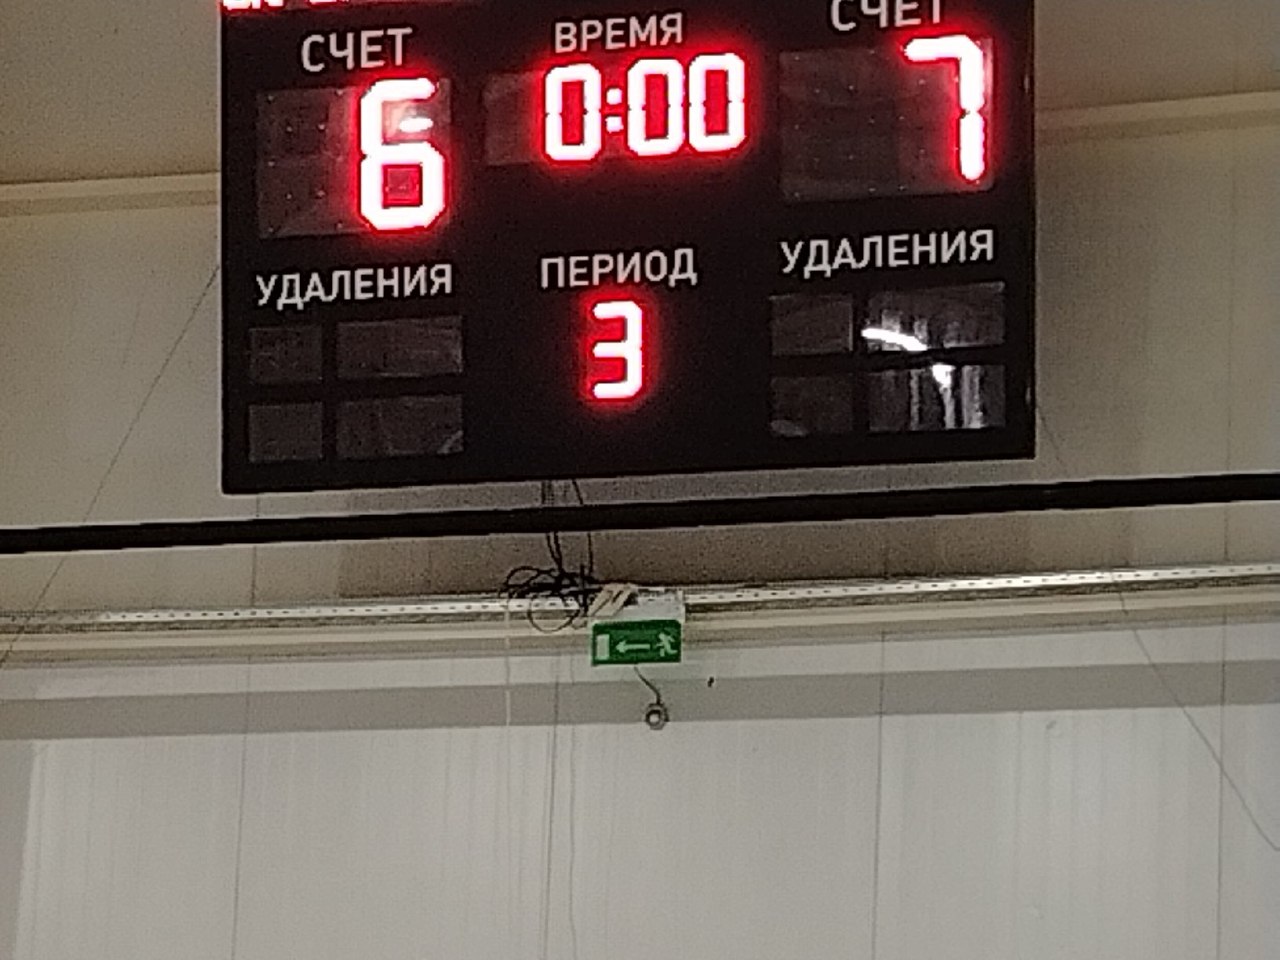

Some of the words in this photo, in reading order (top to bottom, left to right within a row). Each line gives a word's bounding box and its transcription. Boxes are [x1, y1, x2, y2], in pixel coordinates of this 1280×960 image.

[300, 26, 414, 73] СЧЕТ
[553, 13, 684, 54] ВРЕМЯ
[543, 52, 746, 163] 0:00
[904, 35, 985, 181] 7
[358, 77, 446, 231] 6
[540, 248, 698, 289] ПЕРИОД
[780, 229, 996, 277] УДАЛЕНИЯ
[255, 263, 454, 310] УДАЛЕНИЯ
[591, 300, 644, 400] 3
